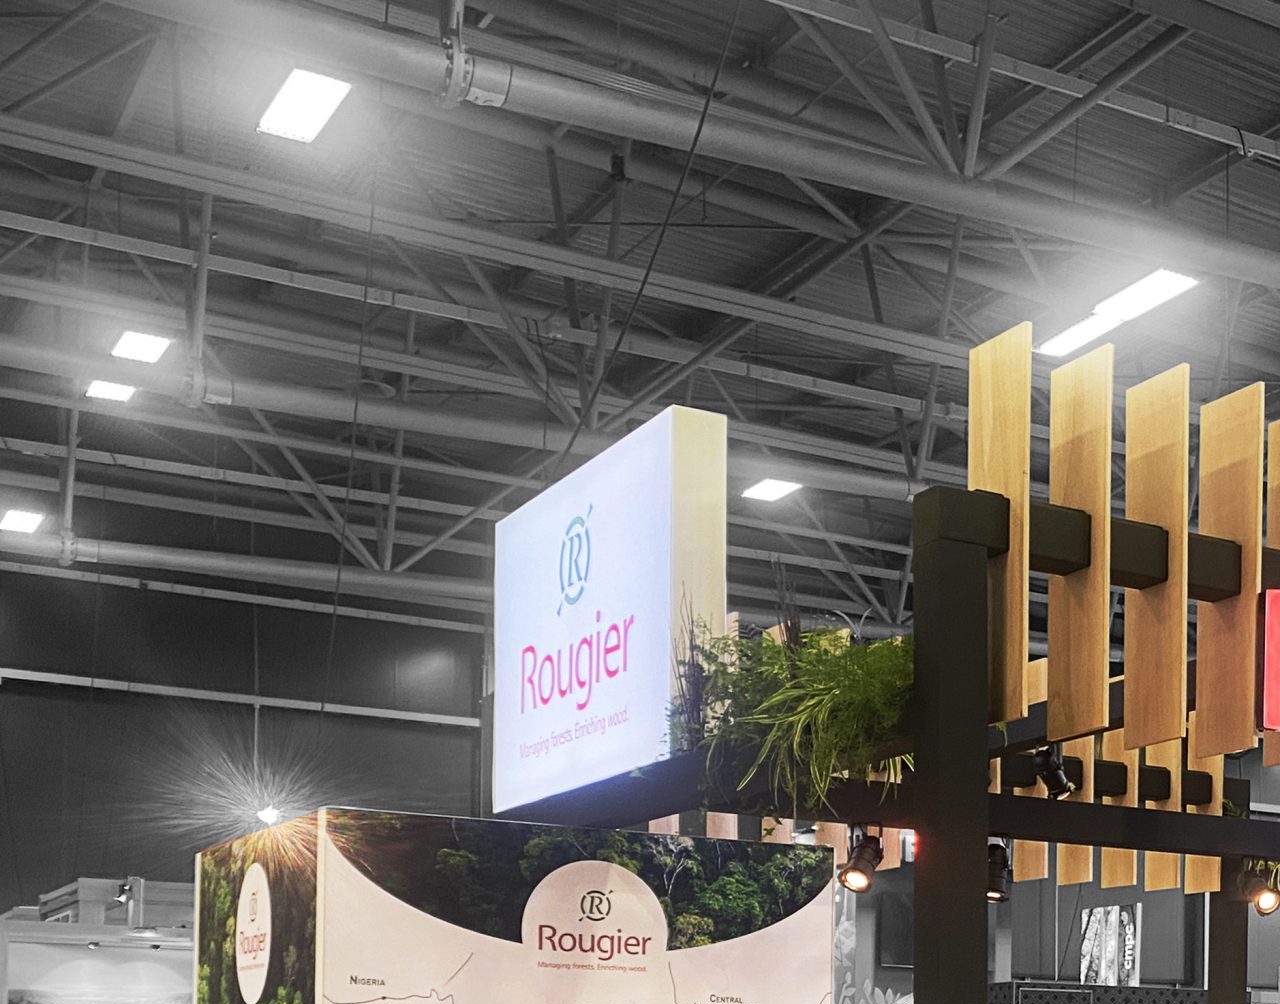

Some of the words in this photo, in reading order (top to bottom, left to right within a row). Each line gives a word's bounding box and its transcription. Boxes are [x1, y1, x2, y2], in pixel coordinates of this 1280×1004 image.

[520, 610, 635, 714] Rougier
[538, 925, 652, 961] Rougier
[1124, 922, 1135, 969] cmpc
